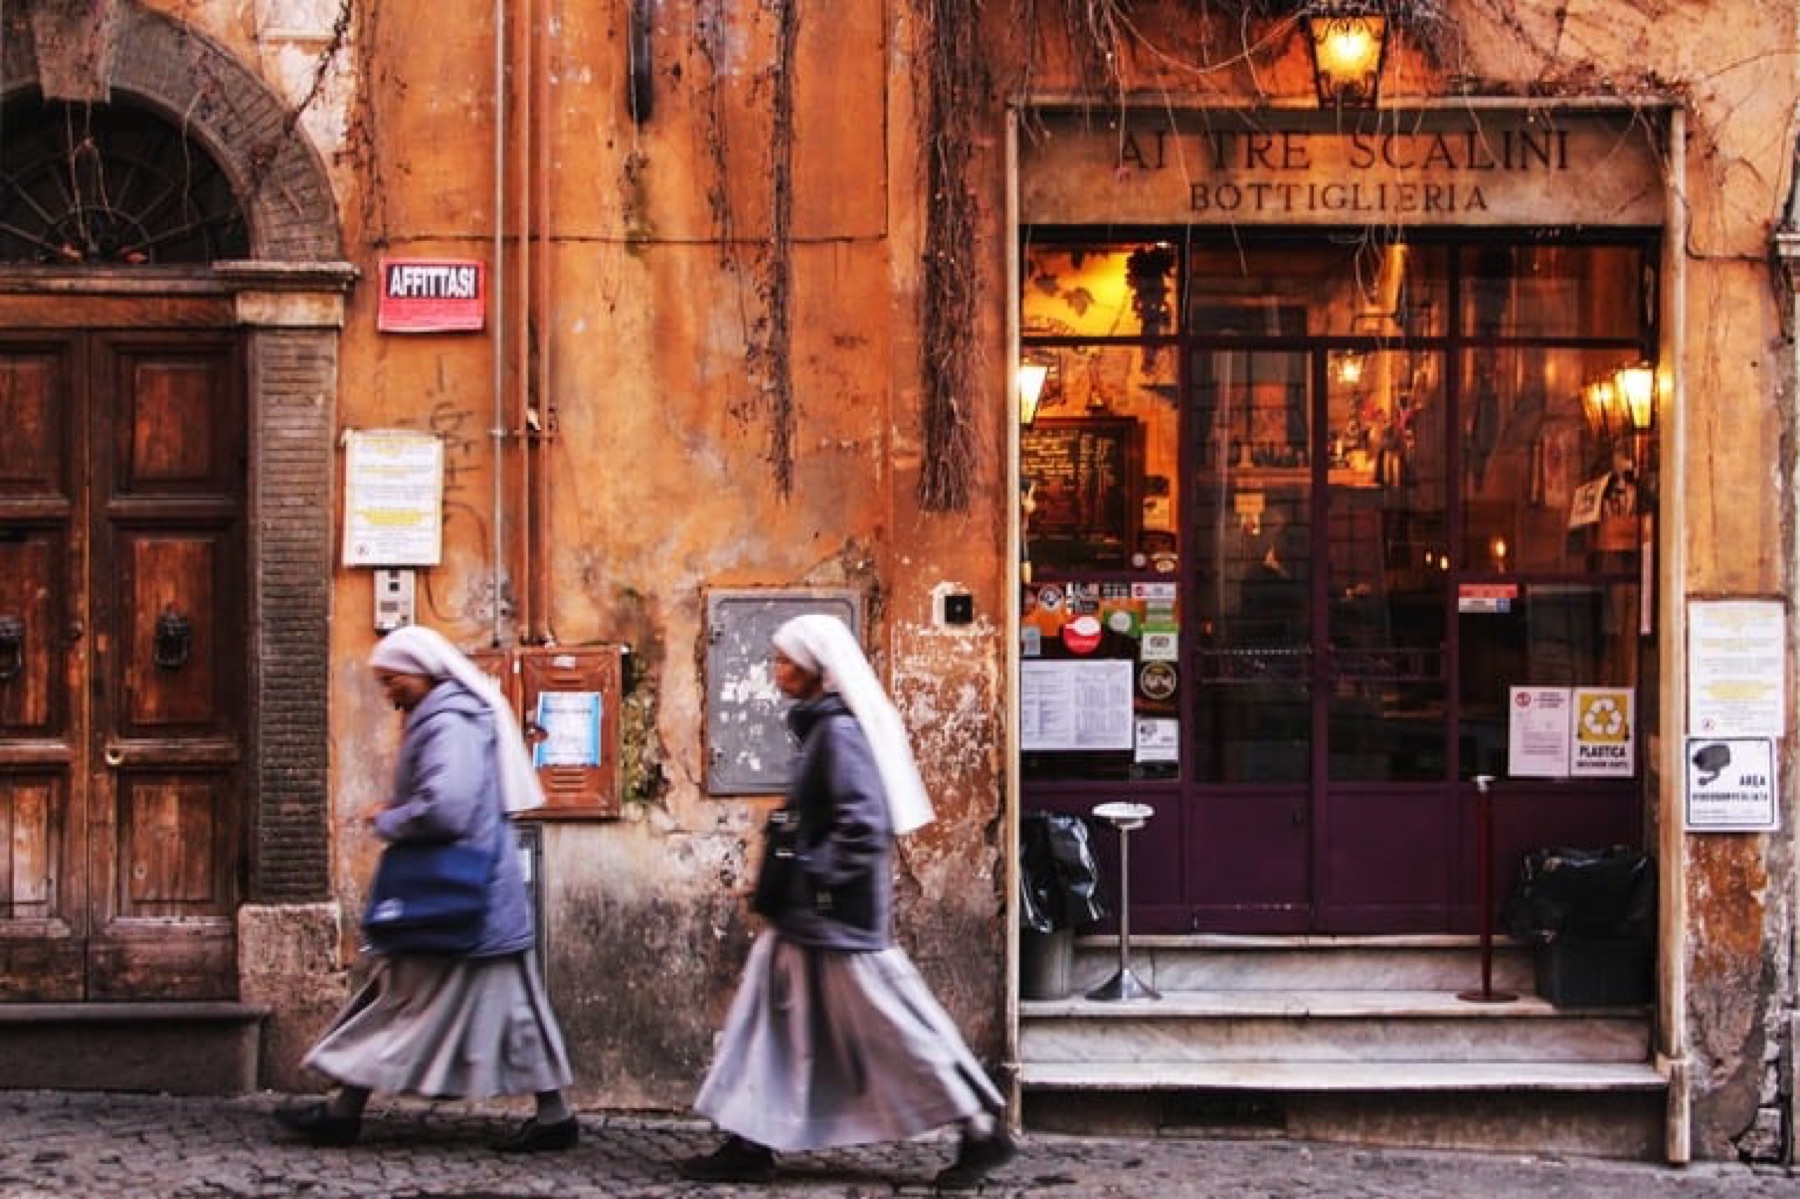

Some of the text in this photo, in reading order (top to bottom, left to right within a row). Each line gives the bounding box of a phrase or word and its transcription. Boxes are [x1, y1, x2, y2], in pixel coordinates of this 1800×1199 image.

[1117, 129, 1569, 170] AI TRE SCALINI
[1189, 183, 1488, 211] BOTTIGLIERIA
[389, 265, 476, 298] AFFITTASI
